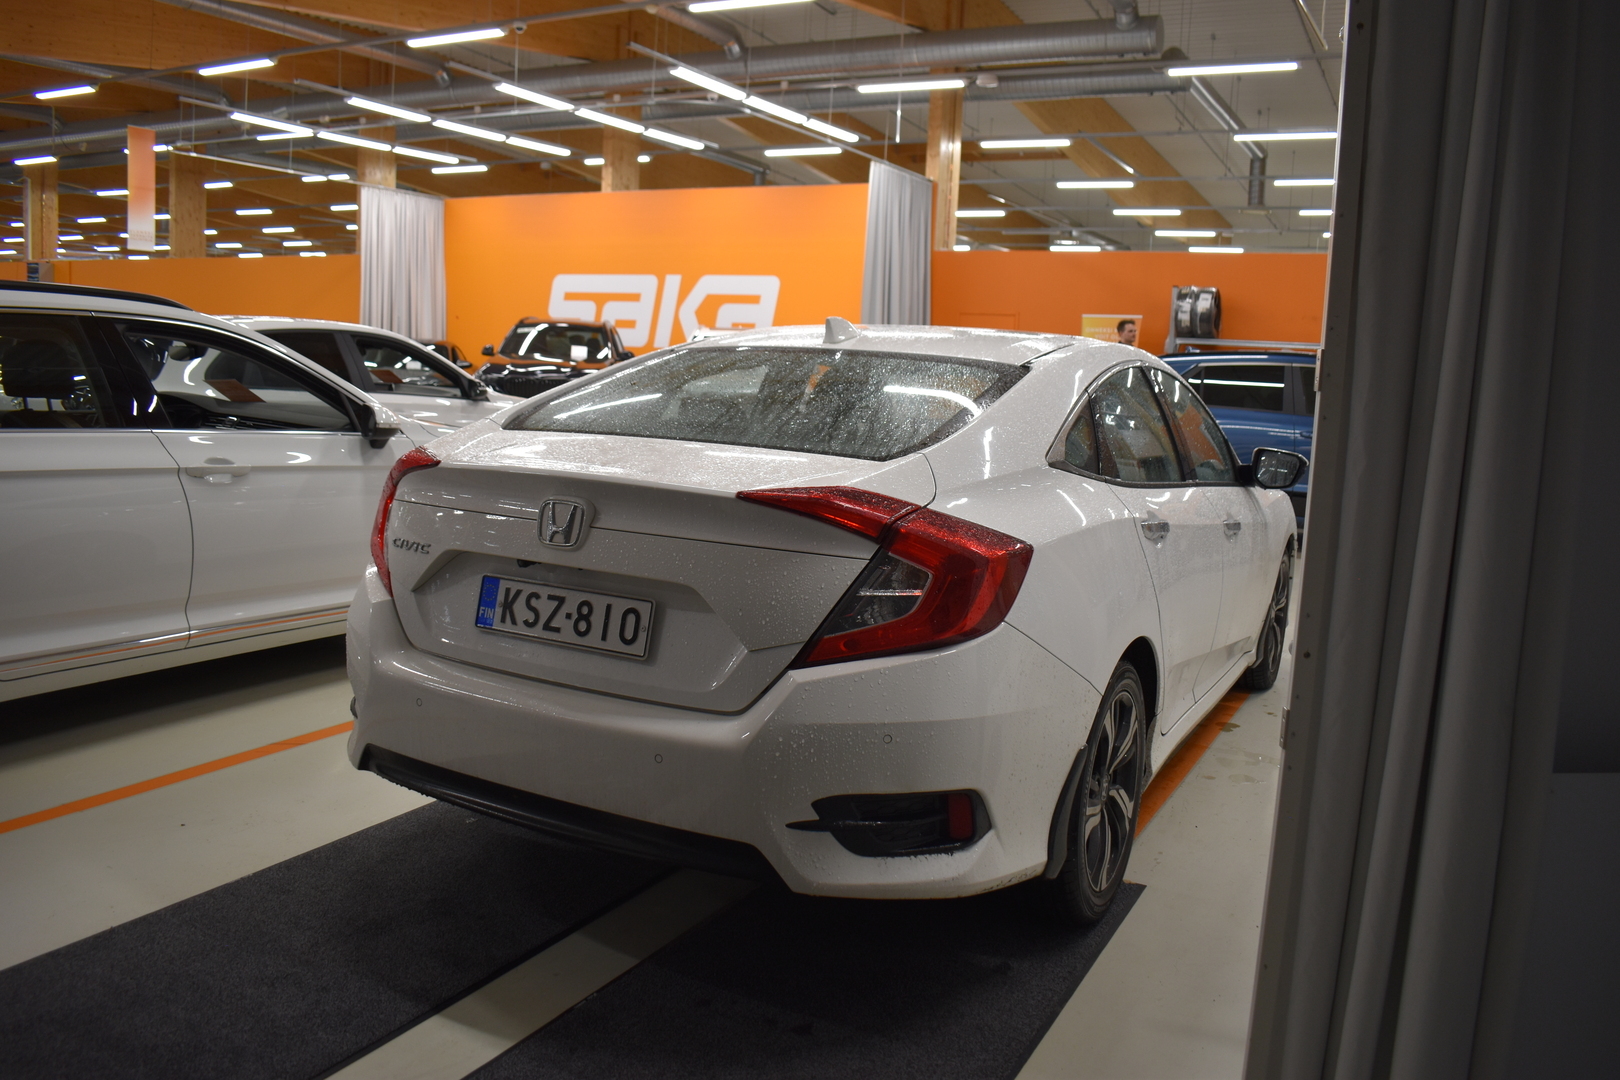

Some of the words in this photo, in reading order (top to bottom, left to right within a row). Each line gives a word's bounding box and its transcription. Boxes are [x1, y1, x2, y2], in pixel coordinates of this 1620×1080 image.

[392, 538, 432, 554] CIVIC
[478, 606, 495, 619] FIN
[500, 587, 641, 646] KSZ-810
